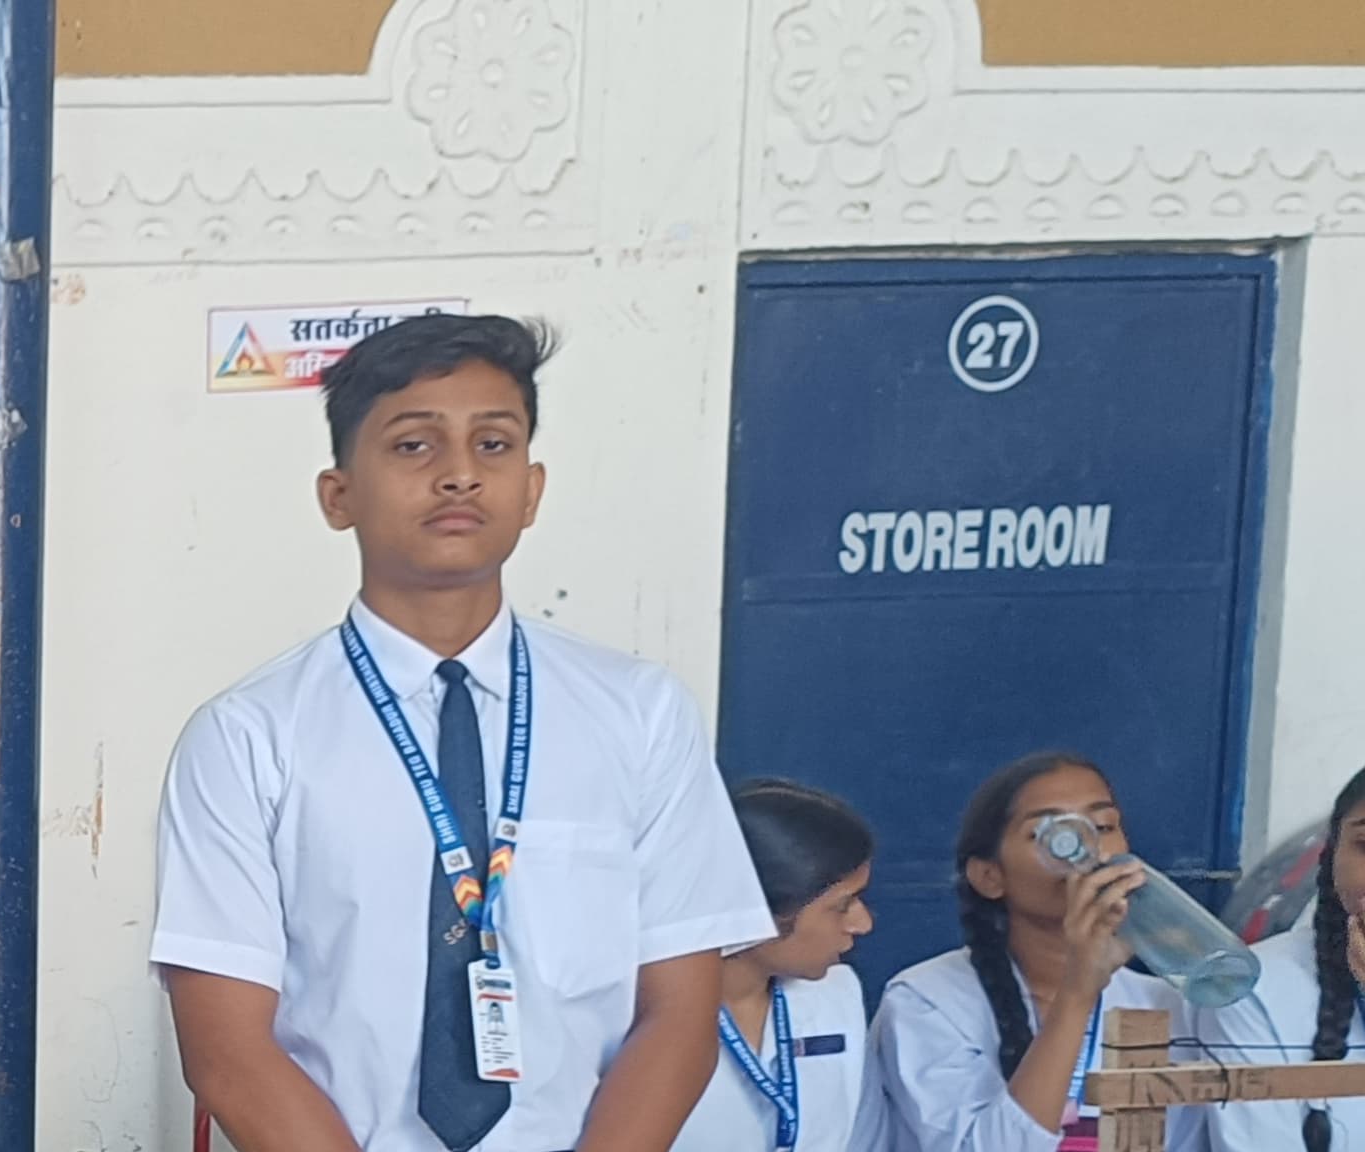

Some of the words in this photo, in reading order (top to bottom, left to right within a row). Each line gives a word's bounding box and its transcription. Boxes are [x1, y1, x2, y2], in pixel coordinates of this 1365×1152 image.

[965, 320, 1024, 369] 27
[838, 509, 986, 575] STORE
[986, 503, 1112, 569] ROOM
